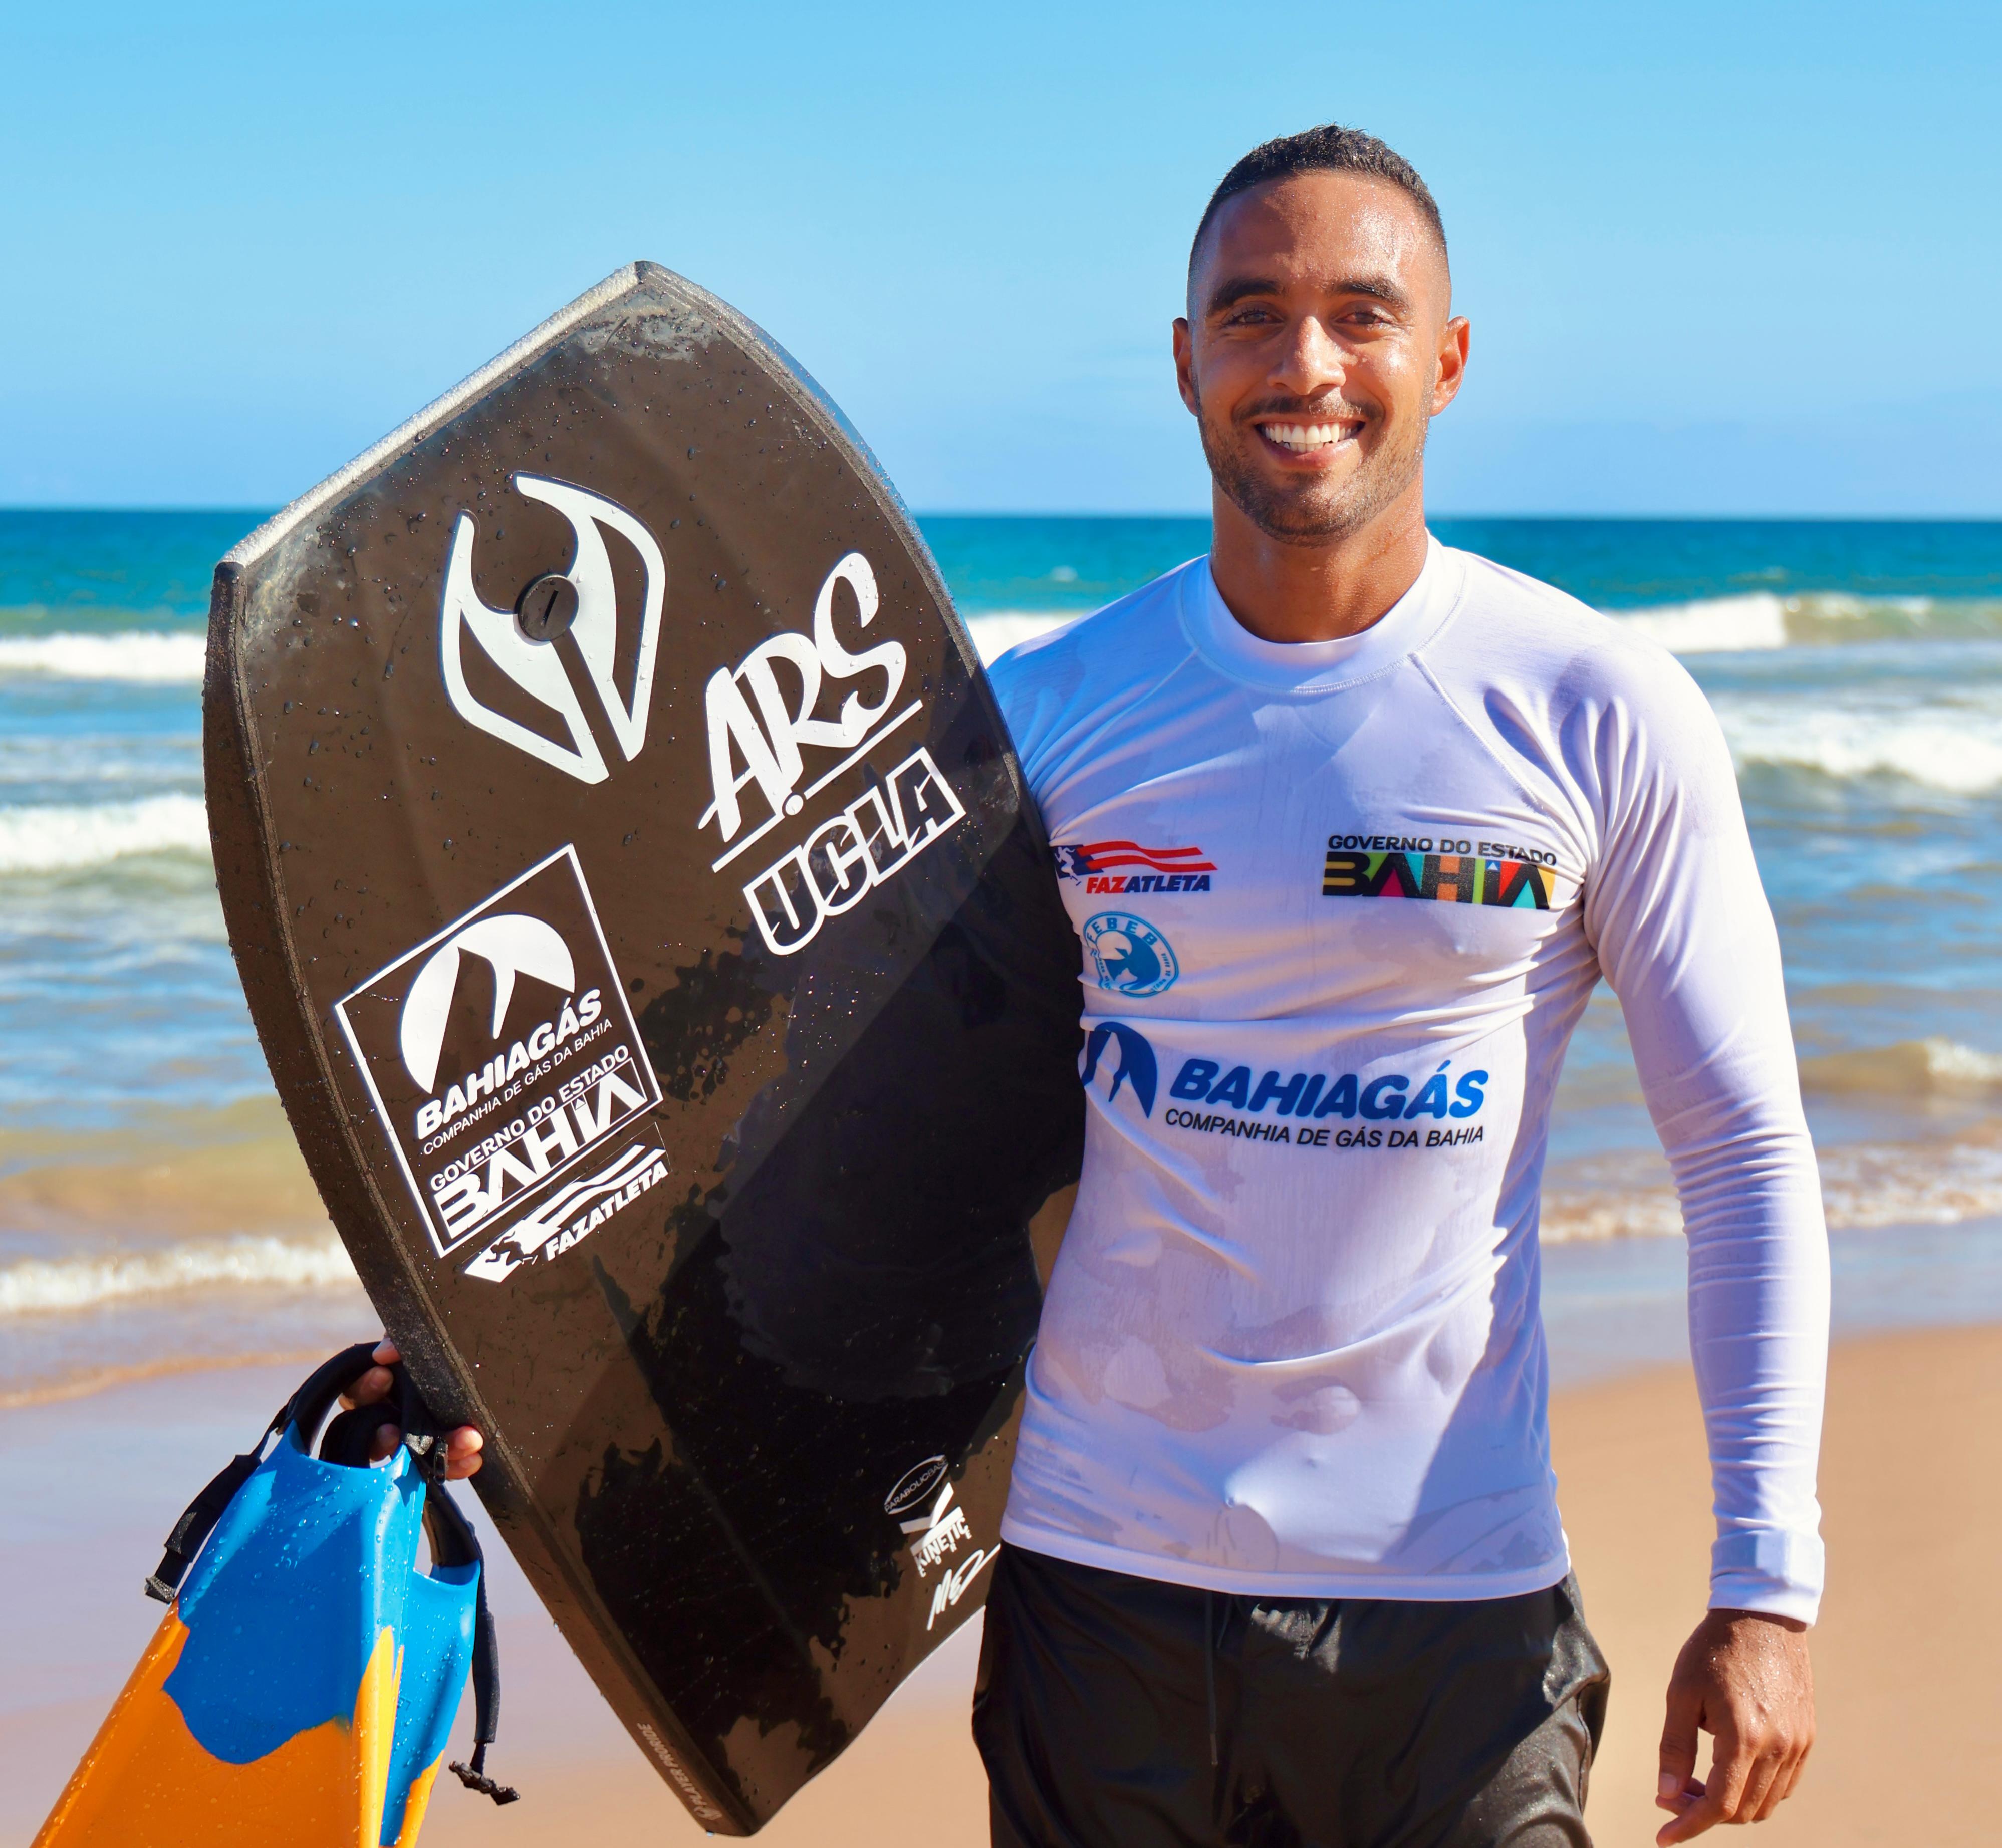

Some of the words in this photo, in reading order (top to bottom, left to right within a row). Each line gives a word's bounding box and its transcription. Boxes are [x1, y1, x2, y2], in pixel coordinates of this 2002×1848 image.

[698, 552, 907, 843] ARS
[742, 747, 966, 956] UCLA
[1086, 875, 1210, 894] FAZATLETA
[1322, 851, 1550, 910] BAHIA
[1328, 835, 1433, 852] GOVERNO
[1439, 839, 1471, 854] DO
[1478, 841, 1557, 866] ESTADO
[1087, 917, 1158, 946] FEBEB
[417, 988, 602, 1140] BAHIAGÁS
[423, 1095, 502, 1155] COMPANHIA
[504, 1083, 523, 1102] DE
[524, 1058, 552, 1087] GÁS
[554, 1046, 573, 1066] DA
[575, 1018, 613, 1053] BAHIA
[1169, 1058, 1489, 1120] BAHIAGÁS
[430, 1120, 526, 1192] GOVERNO
[527, 1096, 556, 1123] DO
[558, 1044, 629, 1102] ESTADO
[434, 1069, 648, 1239] BAHIA
[1165, 1108, 1290, 1144] COMPANHIA
[1297, 1127, 1330, 1146] DE
[1335, 1125, 1381, 1148] GÁS
[1387, 1129, 1418, 1148] DA
[1425, 1125, 1484, 1147] BAHIA
[545, 1161, 669, 1261] FAZATLETA
[914, 1517, 966, 1568] KINETIC
